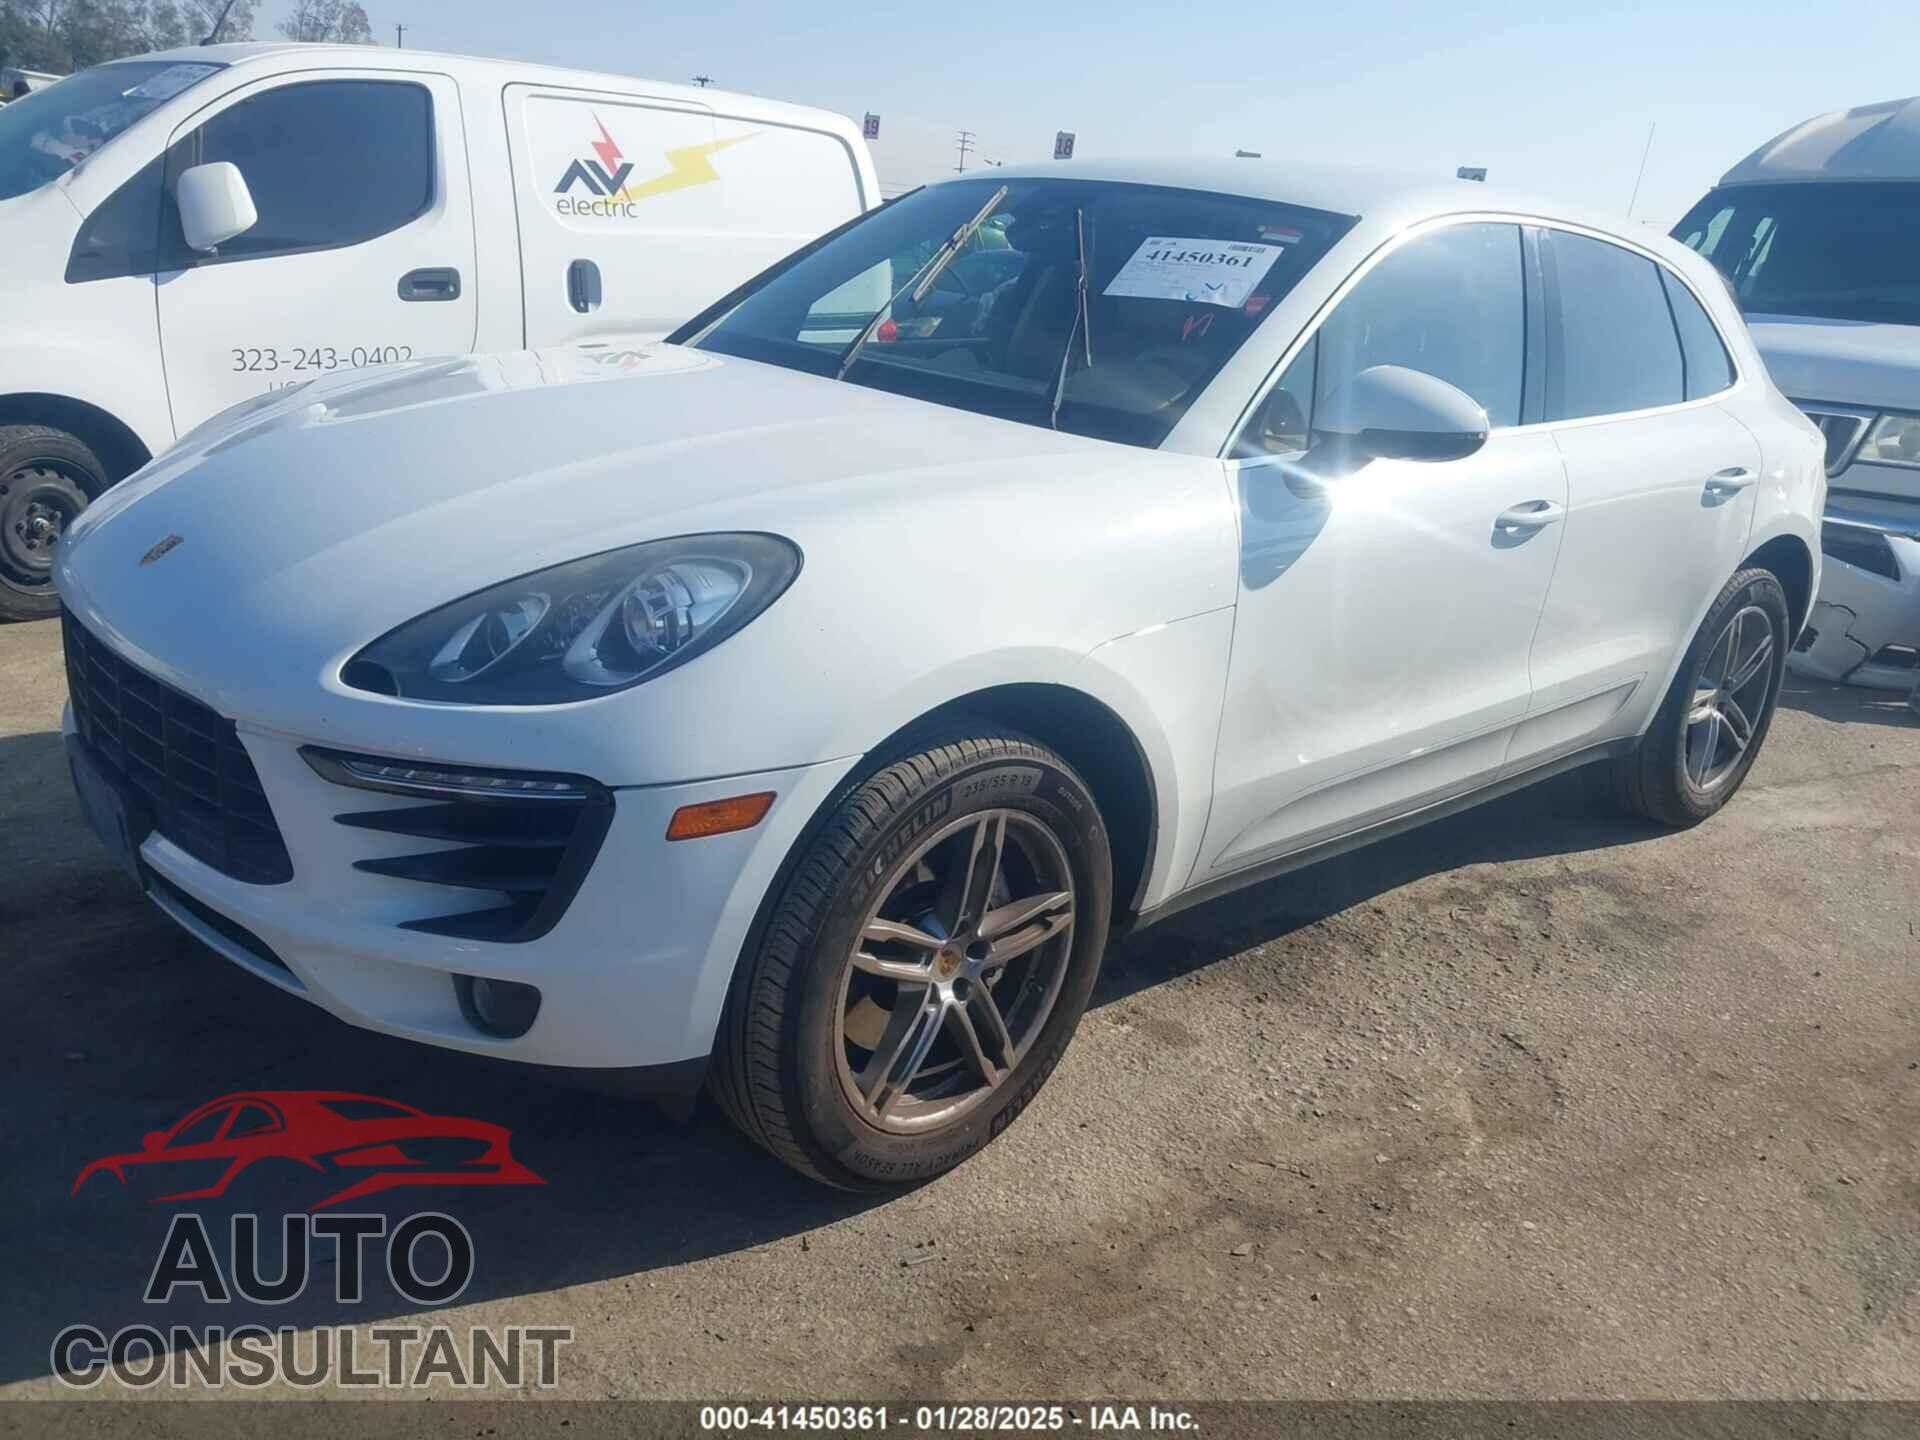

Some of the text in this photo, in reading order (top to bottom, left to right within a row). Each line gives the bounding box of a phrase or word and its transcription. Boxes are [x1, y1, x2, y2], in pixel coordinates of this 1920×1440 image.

[1055, 138, 1073, 156] 18
[553, 158, 635, 197] AV
[556, 195, 639, 218] electric
[1145, 249, 1253, 268] 41450361
